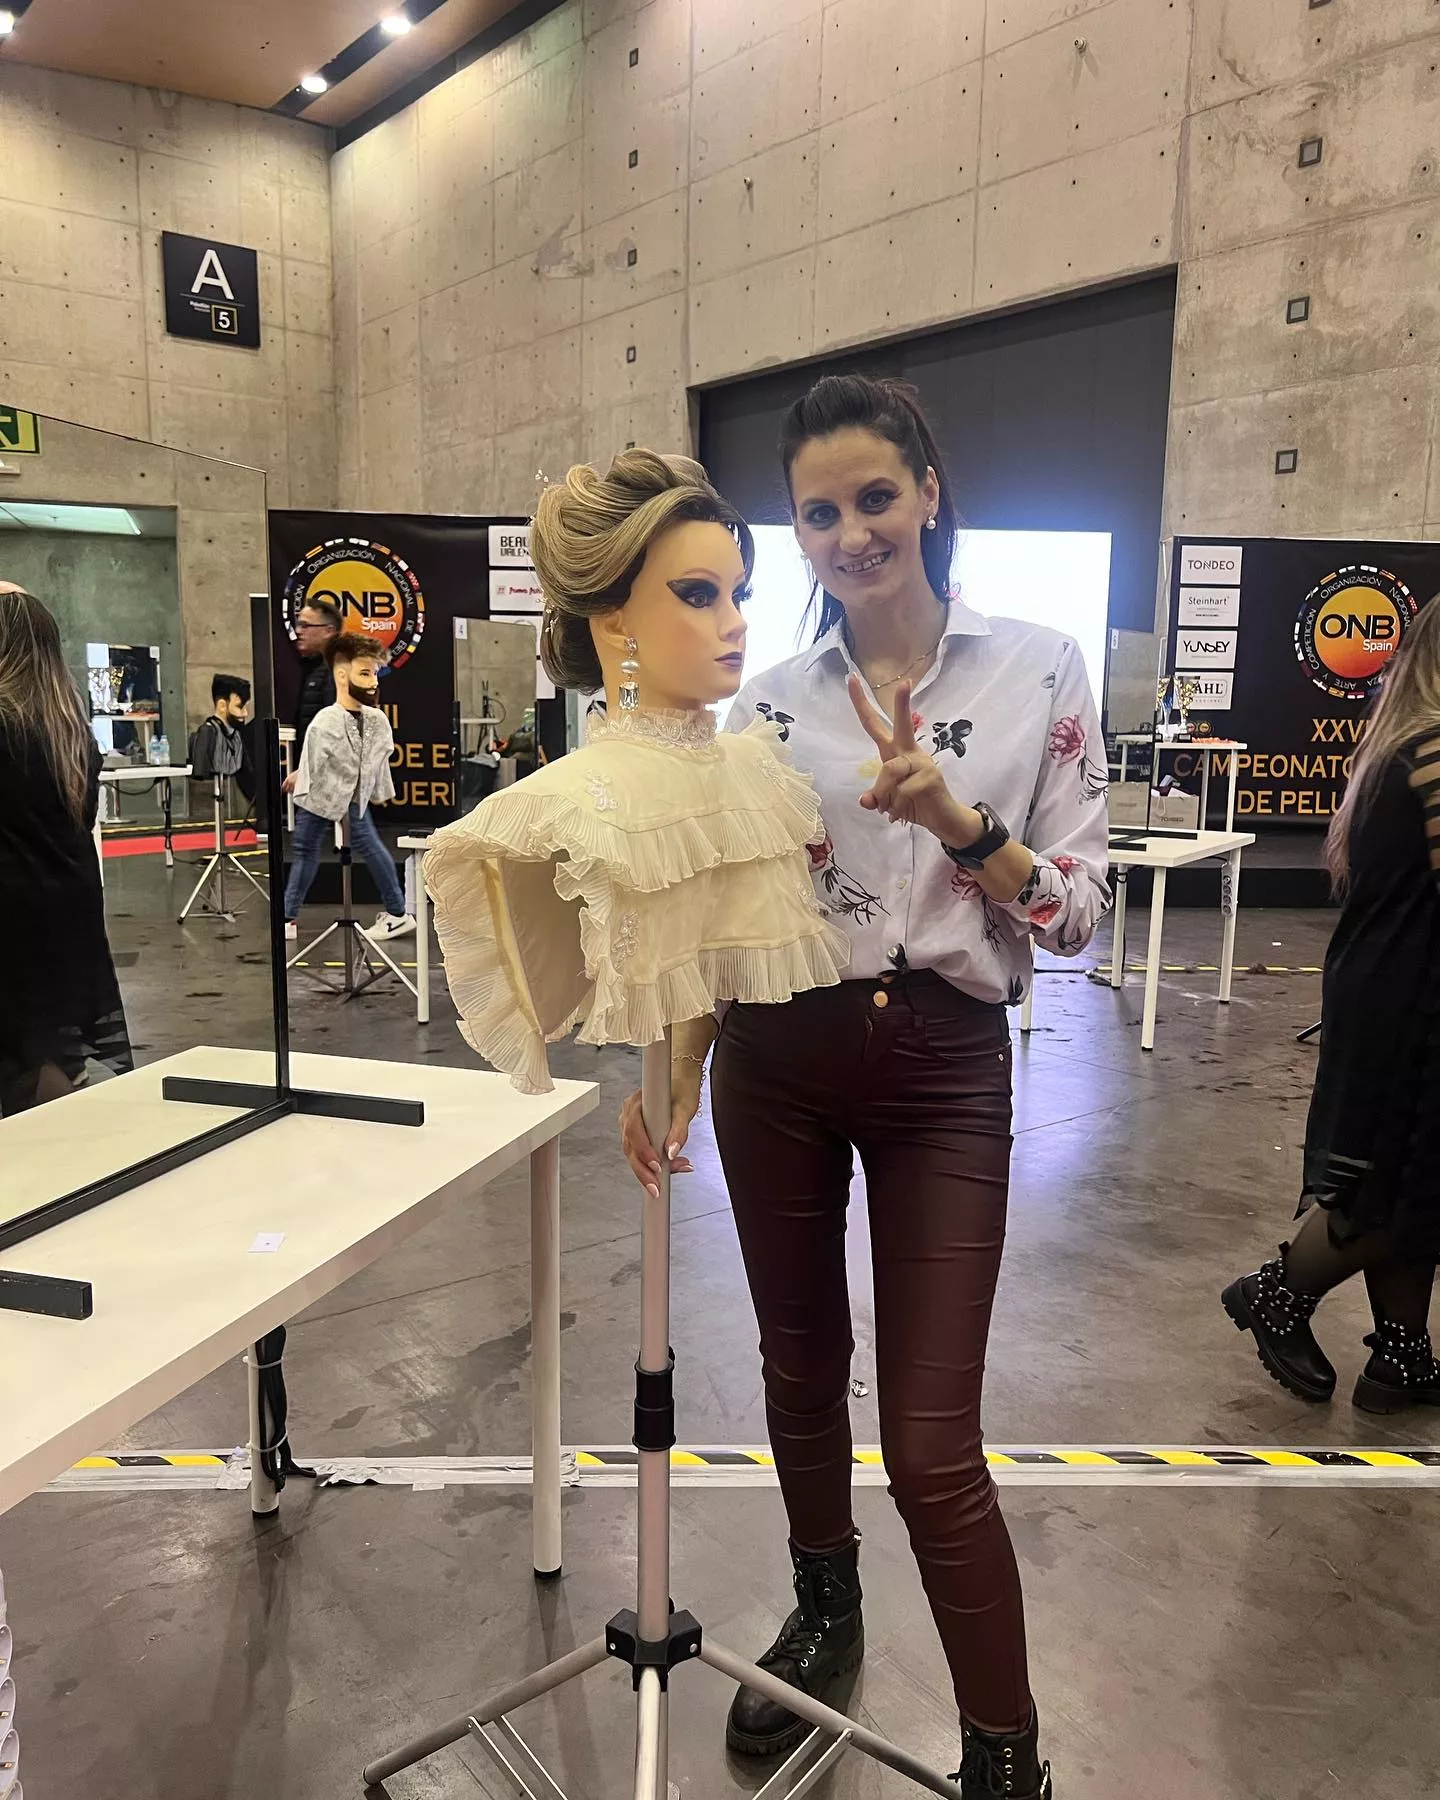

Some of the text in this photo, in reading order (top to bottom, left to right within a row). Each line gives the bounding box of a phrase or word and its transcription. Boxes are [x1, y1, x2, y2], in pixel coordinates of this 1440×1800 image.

[191, 249, 235, 300] A
[218, 311, 231, 329] 5
[1188, 560, 1235, 570] TONDEO
[1188, 596, 1227, 605] Steinhart
[361, 616, 398, 633] Spain
[1320, 613, 1396, 640] ONB
[1362, 638, 1393, 653] Spain
[1193, 681, 1223, 695] AHL
[1237, 790, 1273, 814] DE
